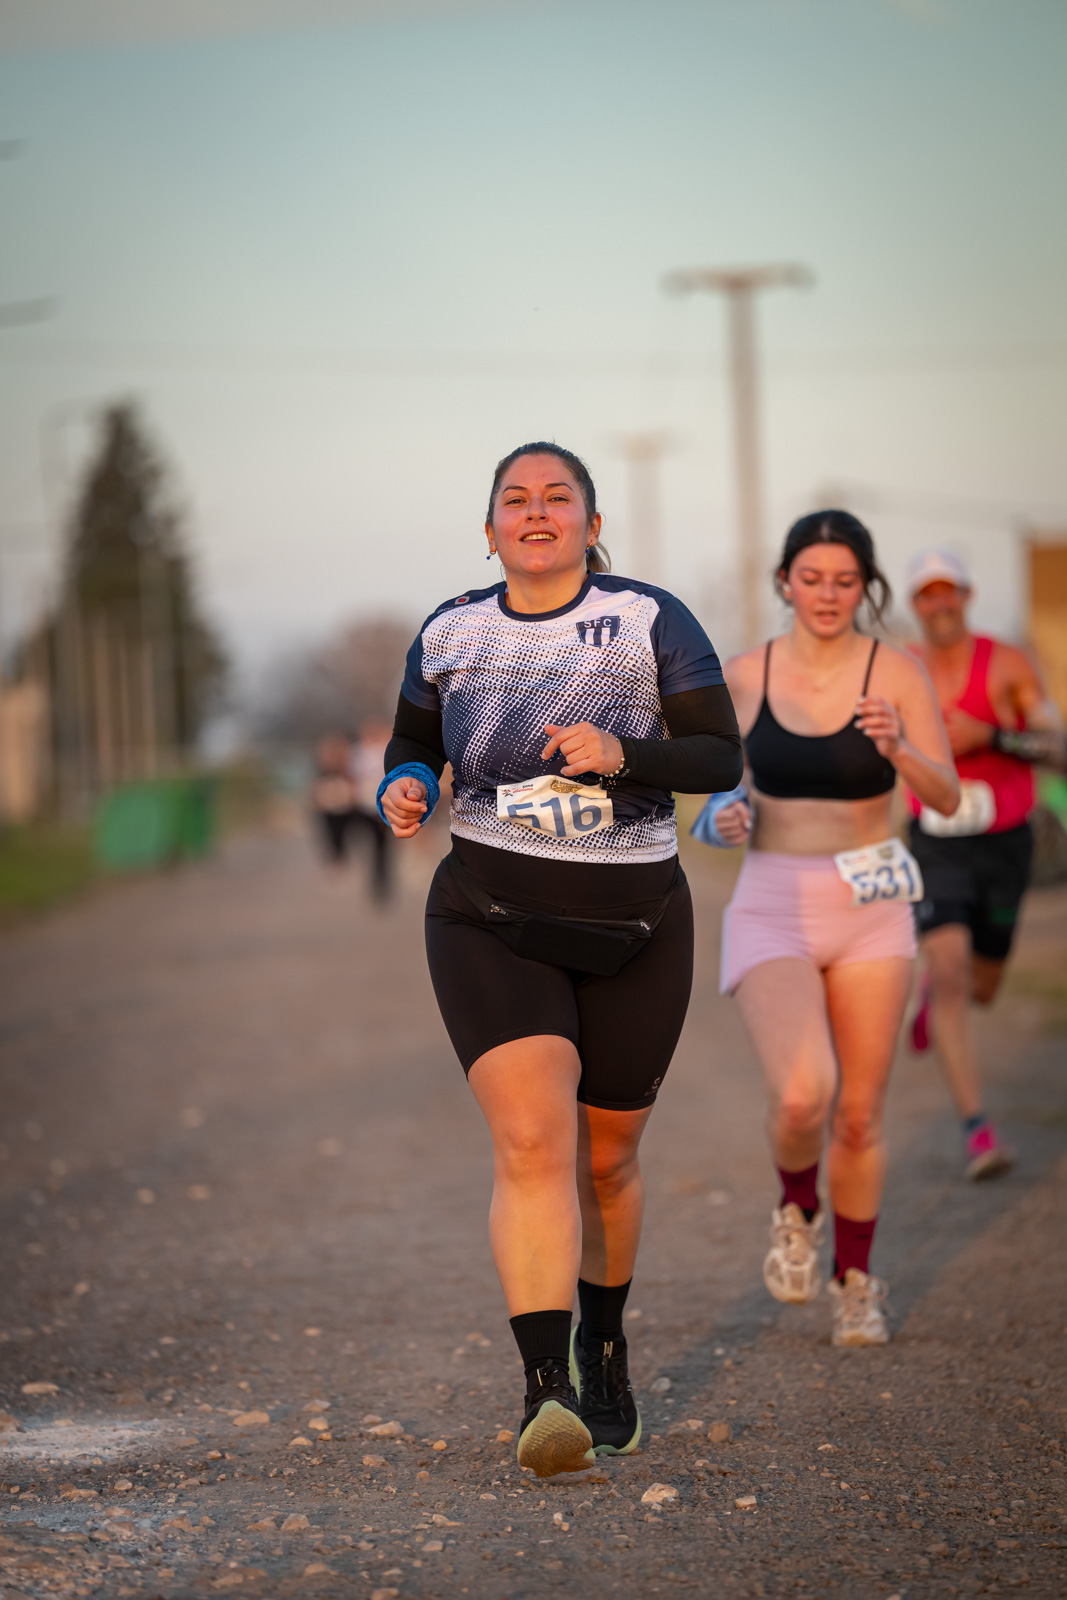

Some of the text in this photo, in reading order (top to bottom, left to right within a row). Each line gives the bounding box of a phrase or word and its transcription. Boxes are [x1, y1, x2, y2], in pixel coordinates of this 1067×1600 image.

[584, 618, 612, 628] SFC
[507, 794, 602, 837] 516
[851, 859, 914, 904] 531
